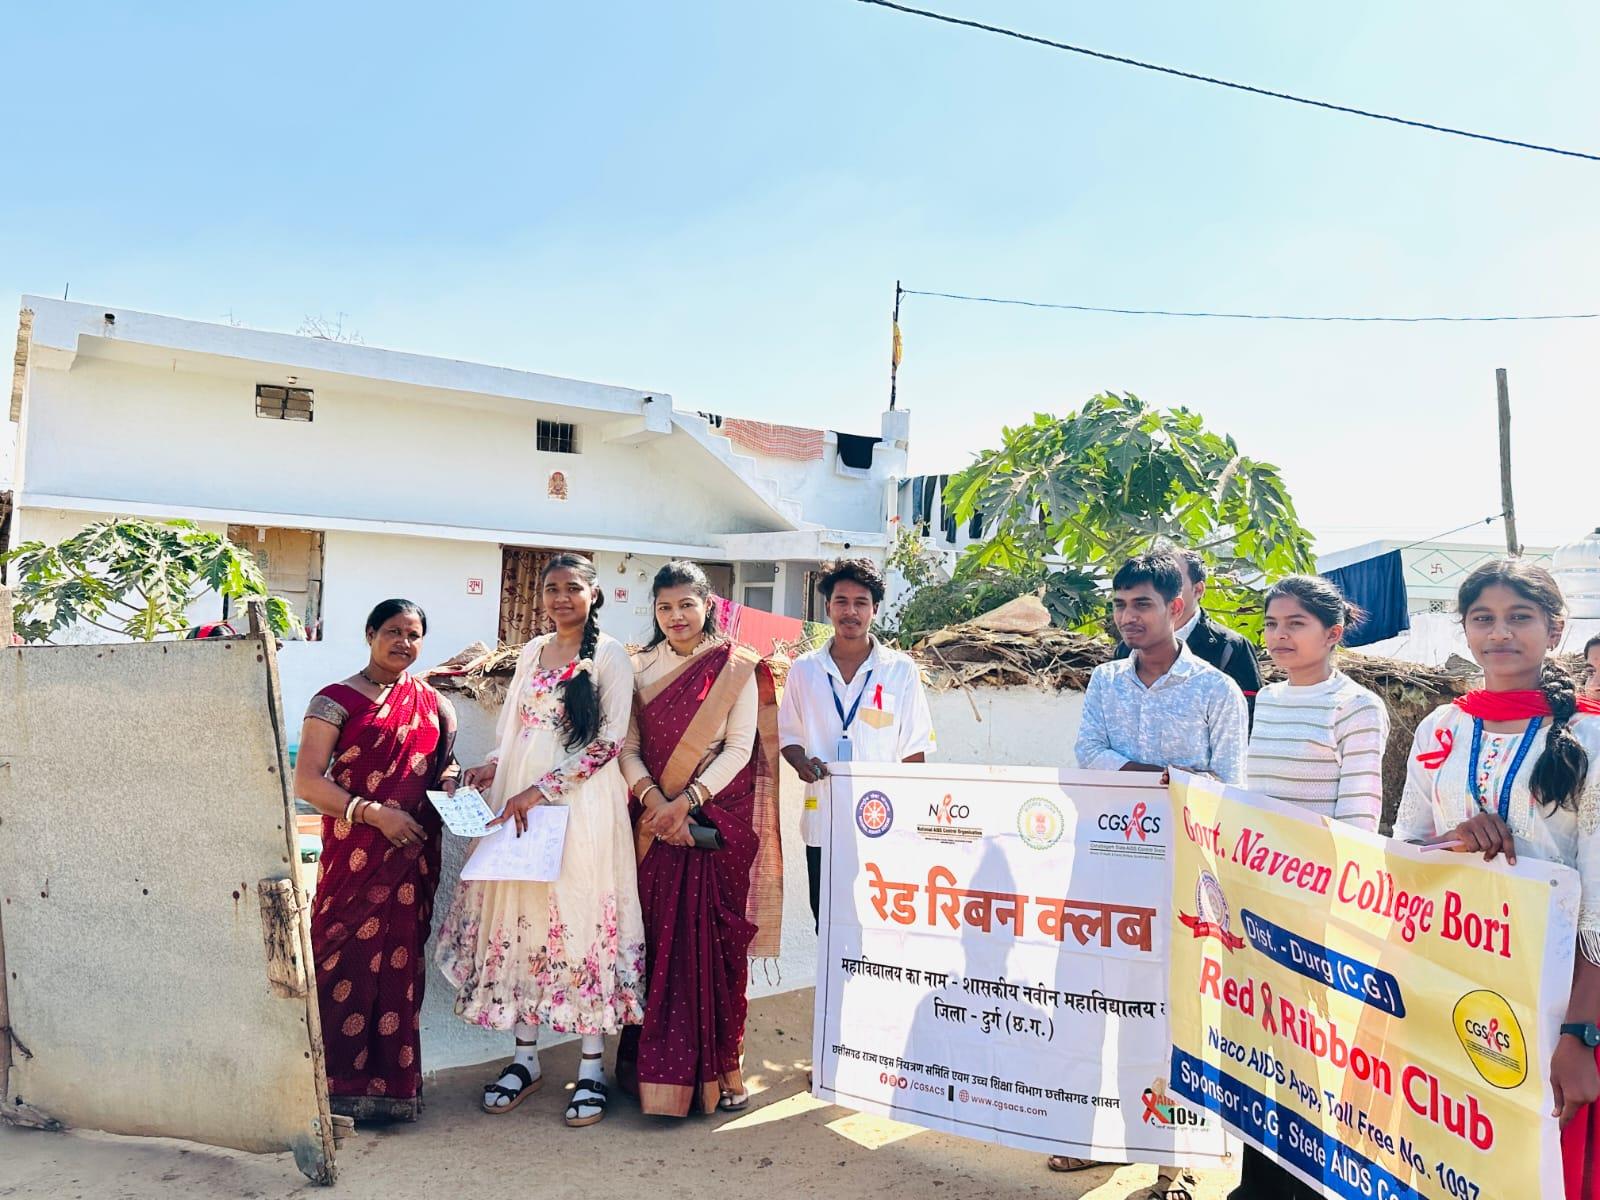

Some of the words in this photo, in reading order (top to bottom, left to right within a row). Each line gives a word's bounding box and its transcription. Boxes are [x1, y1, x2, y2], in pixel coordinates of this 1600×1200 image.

[929, 799, 969, 821] NACO
[1098, 807, 1161, 838] CGSACS
[865, 862, 919, 925] रेड
[925, 865, 1029, 938] रिबन
[1036, 896, 1157, 952] क्लब
[1183, 806, 1226, 858] Govt.
[1231, 828, 1332, 896] Naveen
[1337, 859, 1434, 943] College
[1440, 890, 1511, 958] Bori
[841, 955, 902, 982] महाविद्यालय
[905, 968, 921, 985] का
[924, 971, 949, 990] नाम
[963, 976, 1020, 1001] शासकीय
[1023, 982, 1061, 1008] नवीन
[1064, 989, 1156, 1019] महाविद्यालय
[1245, 916, 1277, 952] Dist.
[1289, 942, 1334, 982] Durg
[1336, 964, 1396, 1011] (C.G.)
[934, 996, 967, 1023] जिला
[980, 1007, 1001, 1034] दुर्ग
[1465, 1019, 1510, 1050] CGSACS
[862, 1051, 878, 1064] राज्य
[925, 1064, 950, 1080] समिति
[971, 1075, 988, 1087] उच्च
[990, 1076, 1012, 1093] शिक्षा
[1015, 1081, 1042, 1098] विभाग
[1090, 1096, 1120, 1109] शासन
[1199, 957, 1255, 1017] Red
[1279, 996, 1392, 1096] Ribbon
[1402, 1064, 1495, 1150] Club
[971, 1095, 1048, 1117] www.cgsacs.com
[1180, 1060, 1240, 1111] Sponsor
[1252, 1101, 1283, 1140] C.G.
[1288, 1121, 1326, 1166] Stete
[1330, 1150, 1372, 1197] AIDS
[1208, 1025, 1246, 1062] Naco
[1247, 1047, 1286, 1084] AIDS
[1289, 1069, 1322, 1113] App,
[1324, 1090, 1353, 1128] Toll
[1357, 1110, 1395, 1155] Free
[1400, 1136, 1431, 1180] No.
[1435, 1162, 1479, 1200] 1097
